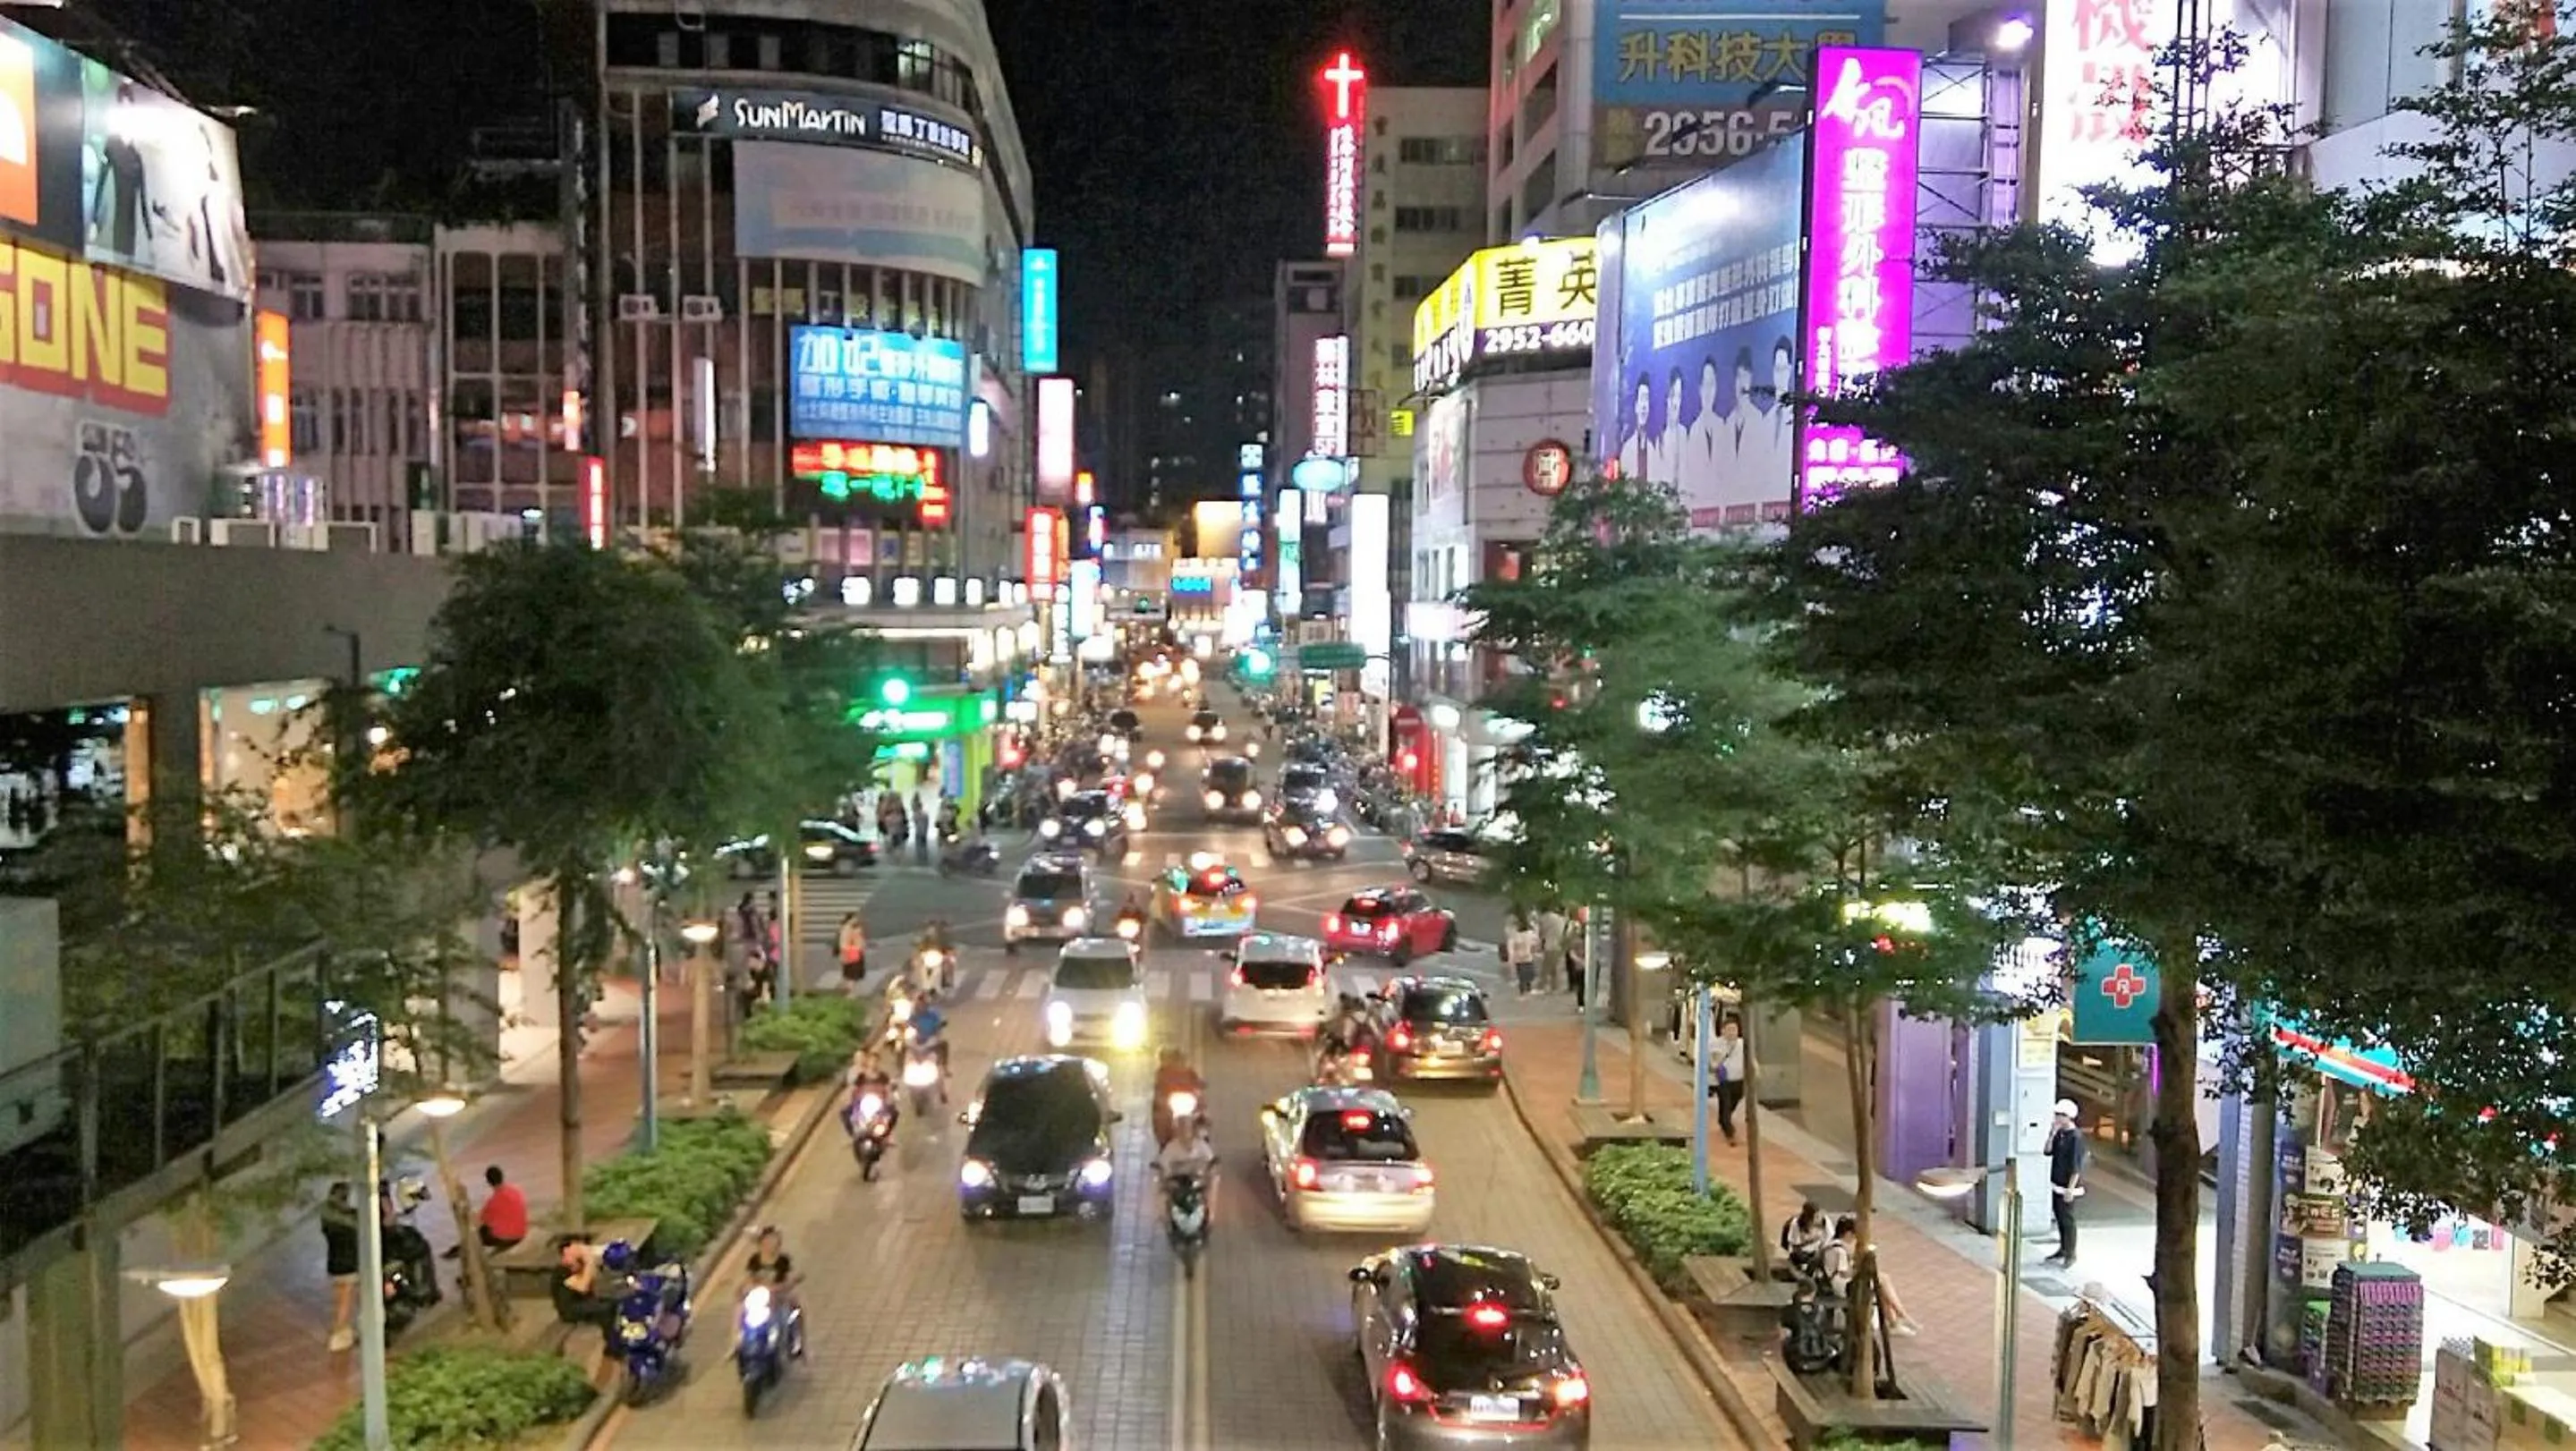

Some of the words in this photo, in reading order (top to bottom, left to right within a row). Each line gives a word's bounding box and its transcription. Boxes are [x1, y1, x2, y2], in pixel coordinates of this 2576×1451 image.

[1618, 29, 1857, 84] 升科技大
[1495, 248, 1597, 318] 菁英
[0, 238, 170, 399] ONE
